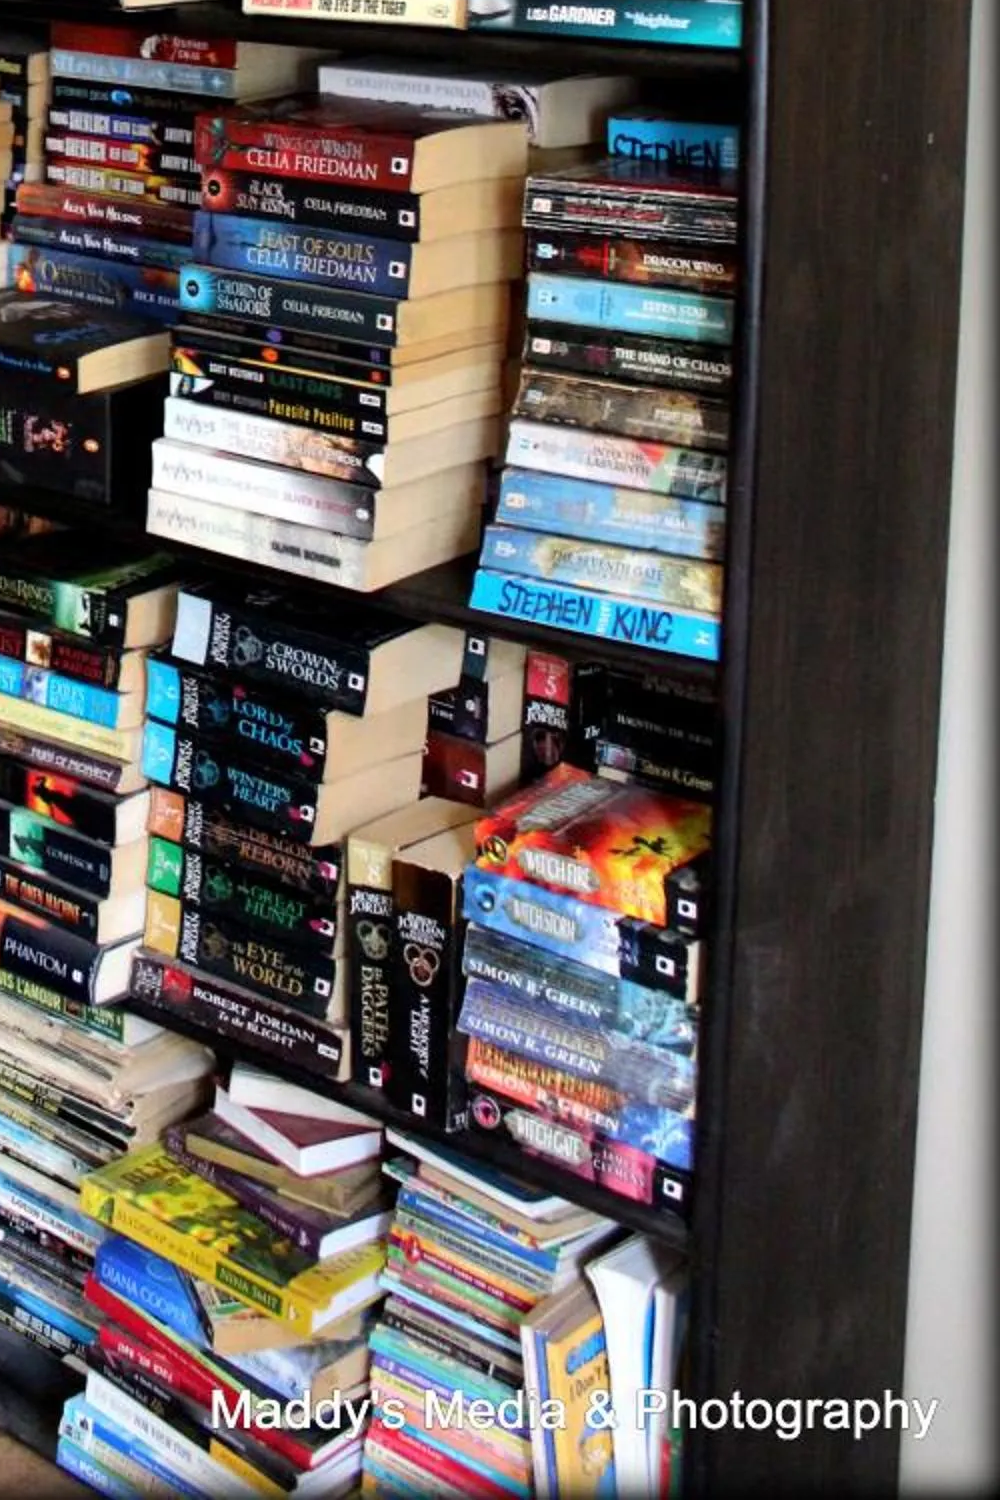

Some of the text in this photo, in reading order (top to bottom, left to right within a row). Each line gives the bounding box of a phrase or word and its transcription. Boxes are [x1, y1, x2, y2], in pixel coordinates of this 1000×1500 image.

[526, 4, 616, 27] LISA GARDNER
[264, 132, 363, 161] WINGS WRATH
[613, 133, 721, 169] STEPHEN
[246, 147, 379, 182] CELIA FRIEDMAN
[249, 179, 285, 199] BLACK
[303, 196, 333, 213] CELIA
[258, 228, 376, 266] FEAST OF SOULS
[643, 252, 726, 275] DRAGON WING
[246, 248, 377, 285] CELIA FRIEDMAN
[615, 346, 672, 367] THE HAND
[268, 397, 356, 433] Parasite Positive
[631, 565, 665, 581] GATE
[497, 579, 673, 645] STEPHEN KING
[265, 657, 339, 690] SWORDS
[273, 641, 337, 673] CROWN
[233, 697, 284, 728] LORD
[237, 719, 304, 756] CHAOS
[227, 766, 292, 802] WINTER'S
[233, 786, 281, 813] HEART
[240, 841, 313, 878] REBORN
[249, 828, 313, 861] DRAGON
[244, 900, 297, 930] HUNT
[252, 883, 307, 917] GREAT
[4, 936, 68, 978] PHANTOM
[247, 942, 283, 967] EYE
[16, 976, 63, 1011] L'AMOUR
[232, 959, 304, 997] WORLD
[468, 958, 602, 1019] SIMON GREEN
[192, 986, 316, 1045] ROBERT JORDAN
[361, 965, 377, 1057] DAGGERS
[217, 1010, 297, 1050] To BLIGHT
[467, 1015, 602, 1076] SIMON GREEN
[471, 1062, 619, 1132] SIMON GREEN
[101, 1264, 190, 1328] DIANA COOPER
